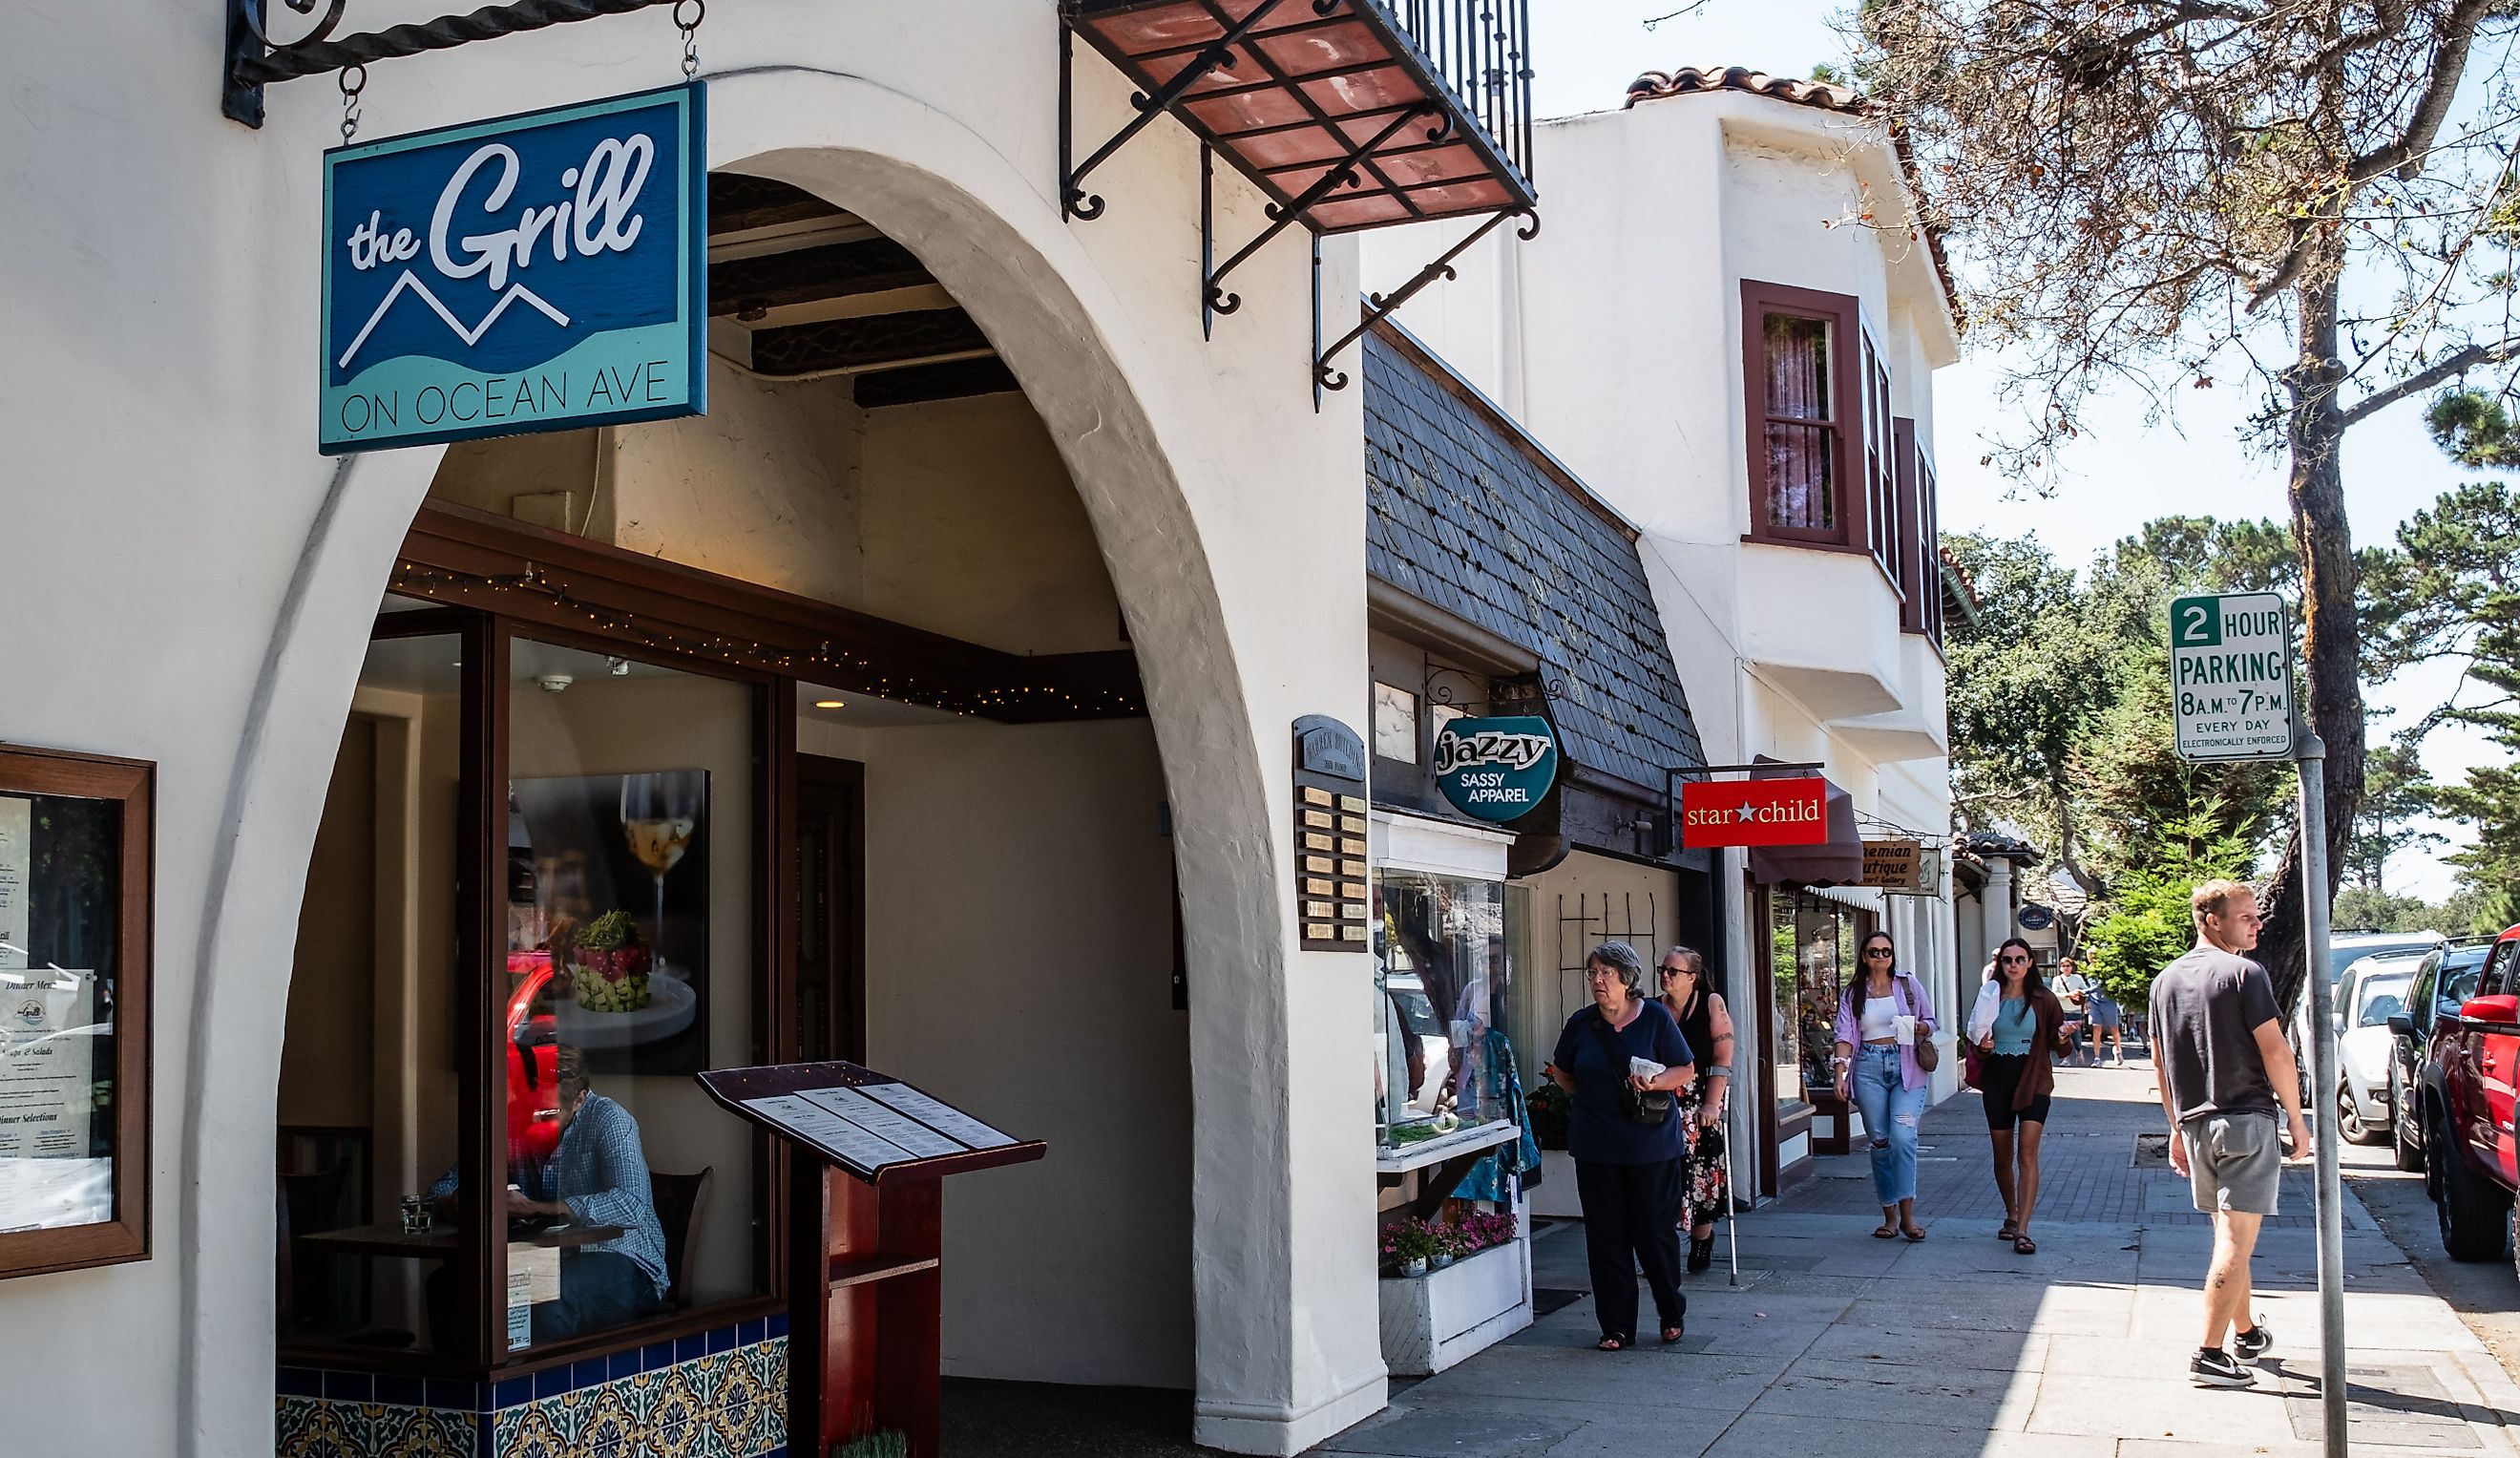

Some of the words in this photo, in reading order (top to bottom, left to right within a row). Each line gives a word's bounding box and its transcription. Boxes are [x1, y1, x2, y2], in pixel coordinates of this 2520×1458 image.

[347, 210, 421, 270] the
[430, 134, 655, 289] Grill
[342, 391, 398, 433] ON
[416, 371, 567, 425] OCEAN
[586, 360, 668, 408] AVE
[2183, 605, 2209, 641] 2
[2225, 611, 2280, 638] HOUR
[2179, 651, 2281, 686] PARKING
[2227, 697, 2237, 706] TO
[2196, 721, 2237, 733] EVERY
[2245, 719, 2270, 731] DAY
[1435, 730, 1551, 775] jazzy
[2182, 737, 2244, 749] ELECTRONICALLY
[2247, 735, 2287, 746] ENFORCED
[1460, 772, 1505, 788] SASSY
[1468, 788, 1530, 803] APPAREL
[1688, 806, 1733, 826] star
[1758, 798, 1820, 823] child
[0, 1115, 21, 1125] inner
[21, 1112, 58, 1124] Selections
